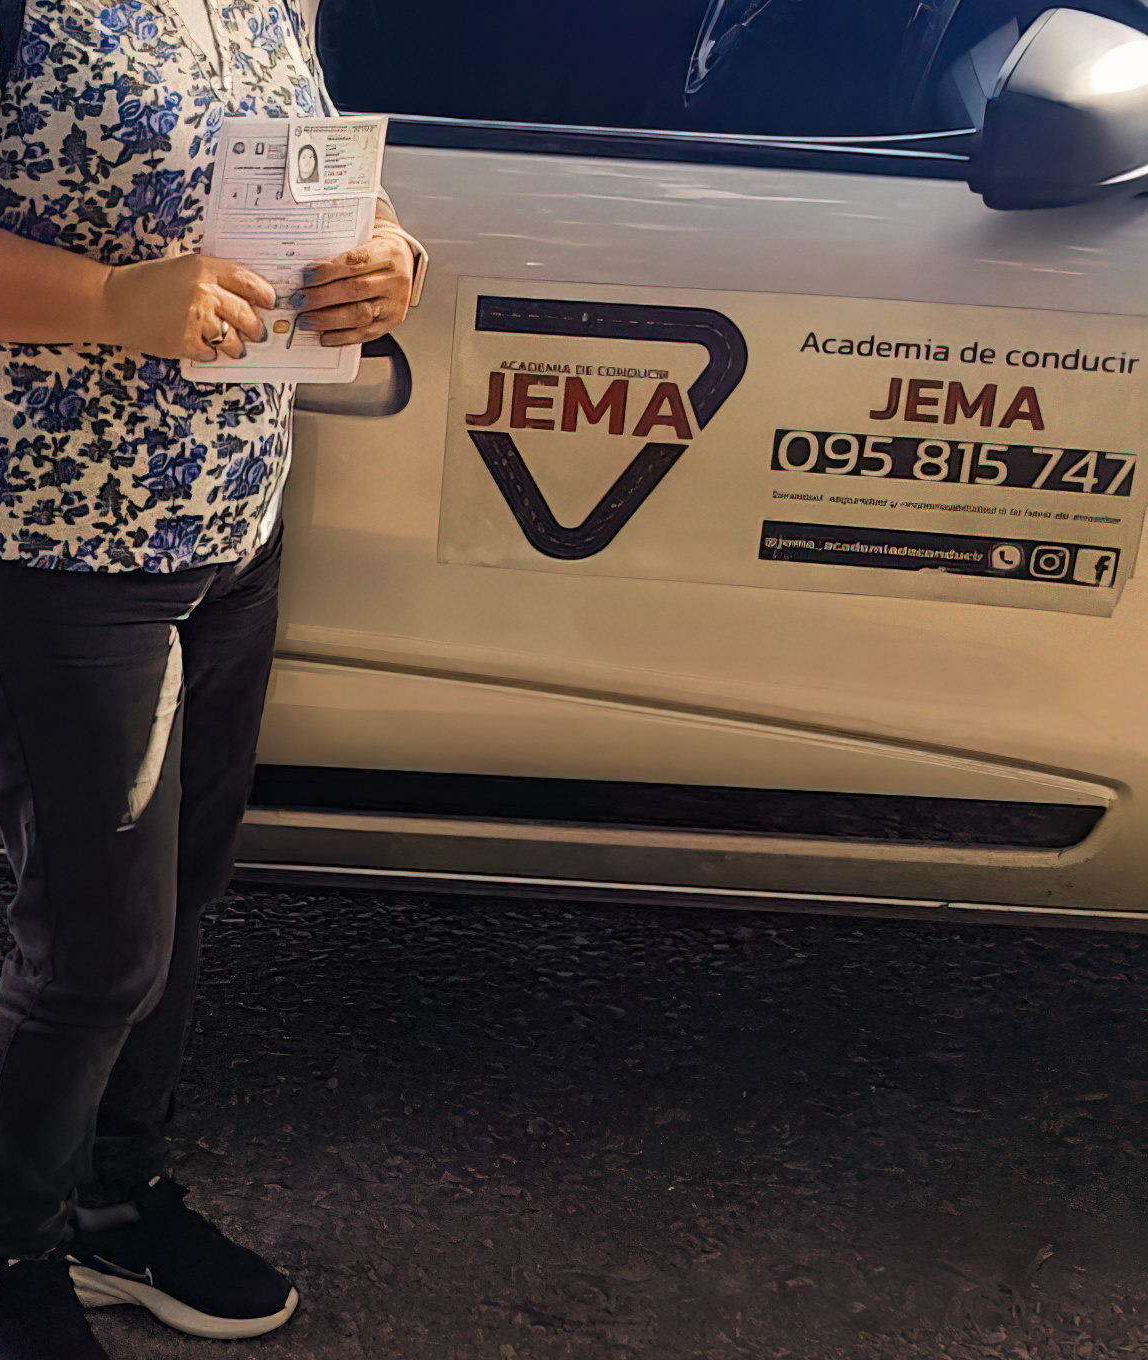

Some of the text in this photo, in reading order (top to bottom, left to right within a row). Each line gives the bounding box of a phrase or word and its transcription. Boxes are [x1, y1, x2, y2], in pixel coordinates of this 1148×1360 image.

[800, 331, 1140, 374] Academia de conducir
[465, 371, 693, 440] JEMA
[869, 377, 1045, 430] JEMA
[777, 430, 1138, 495] 095 815 747
